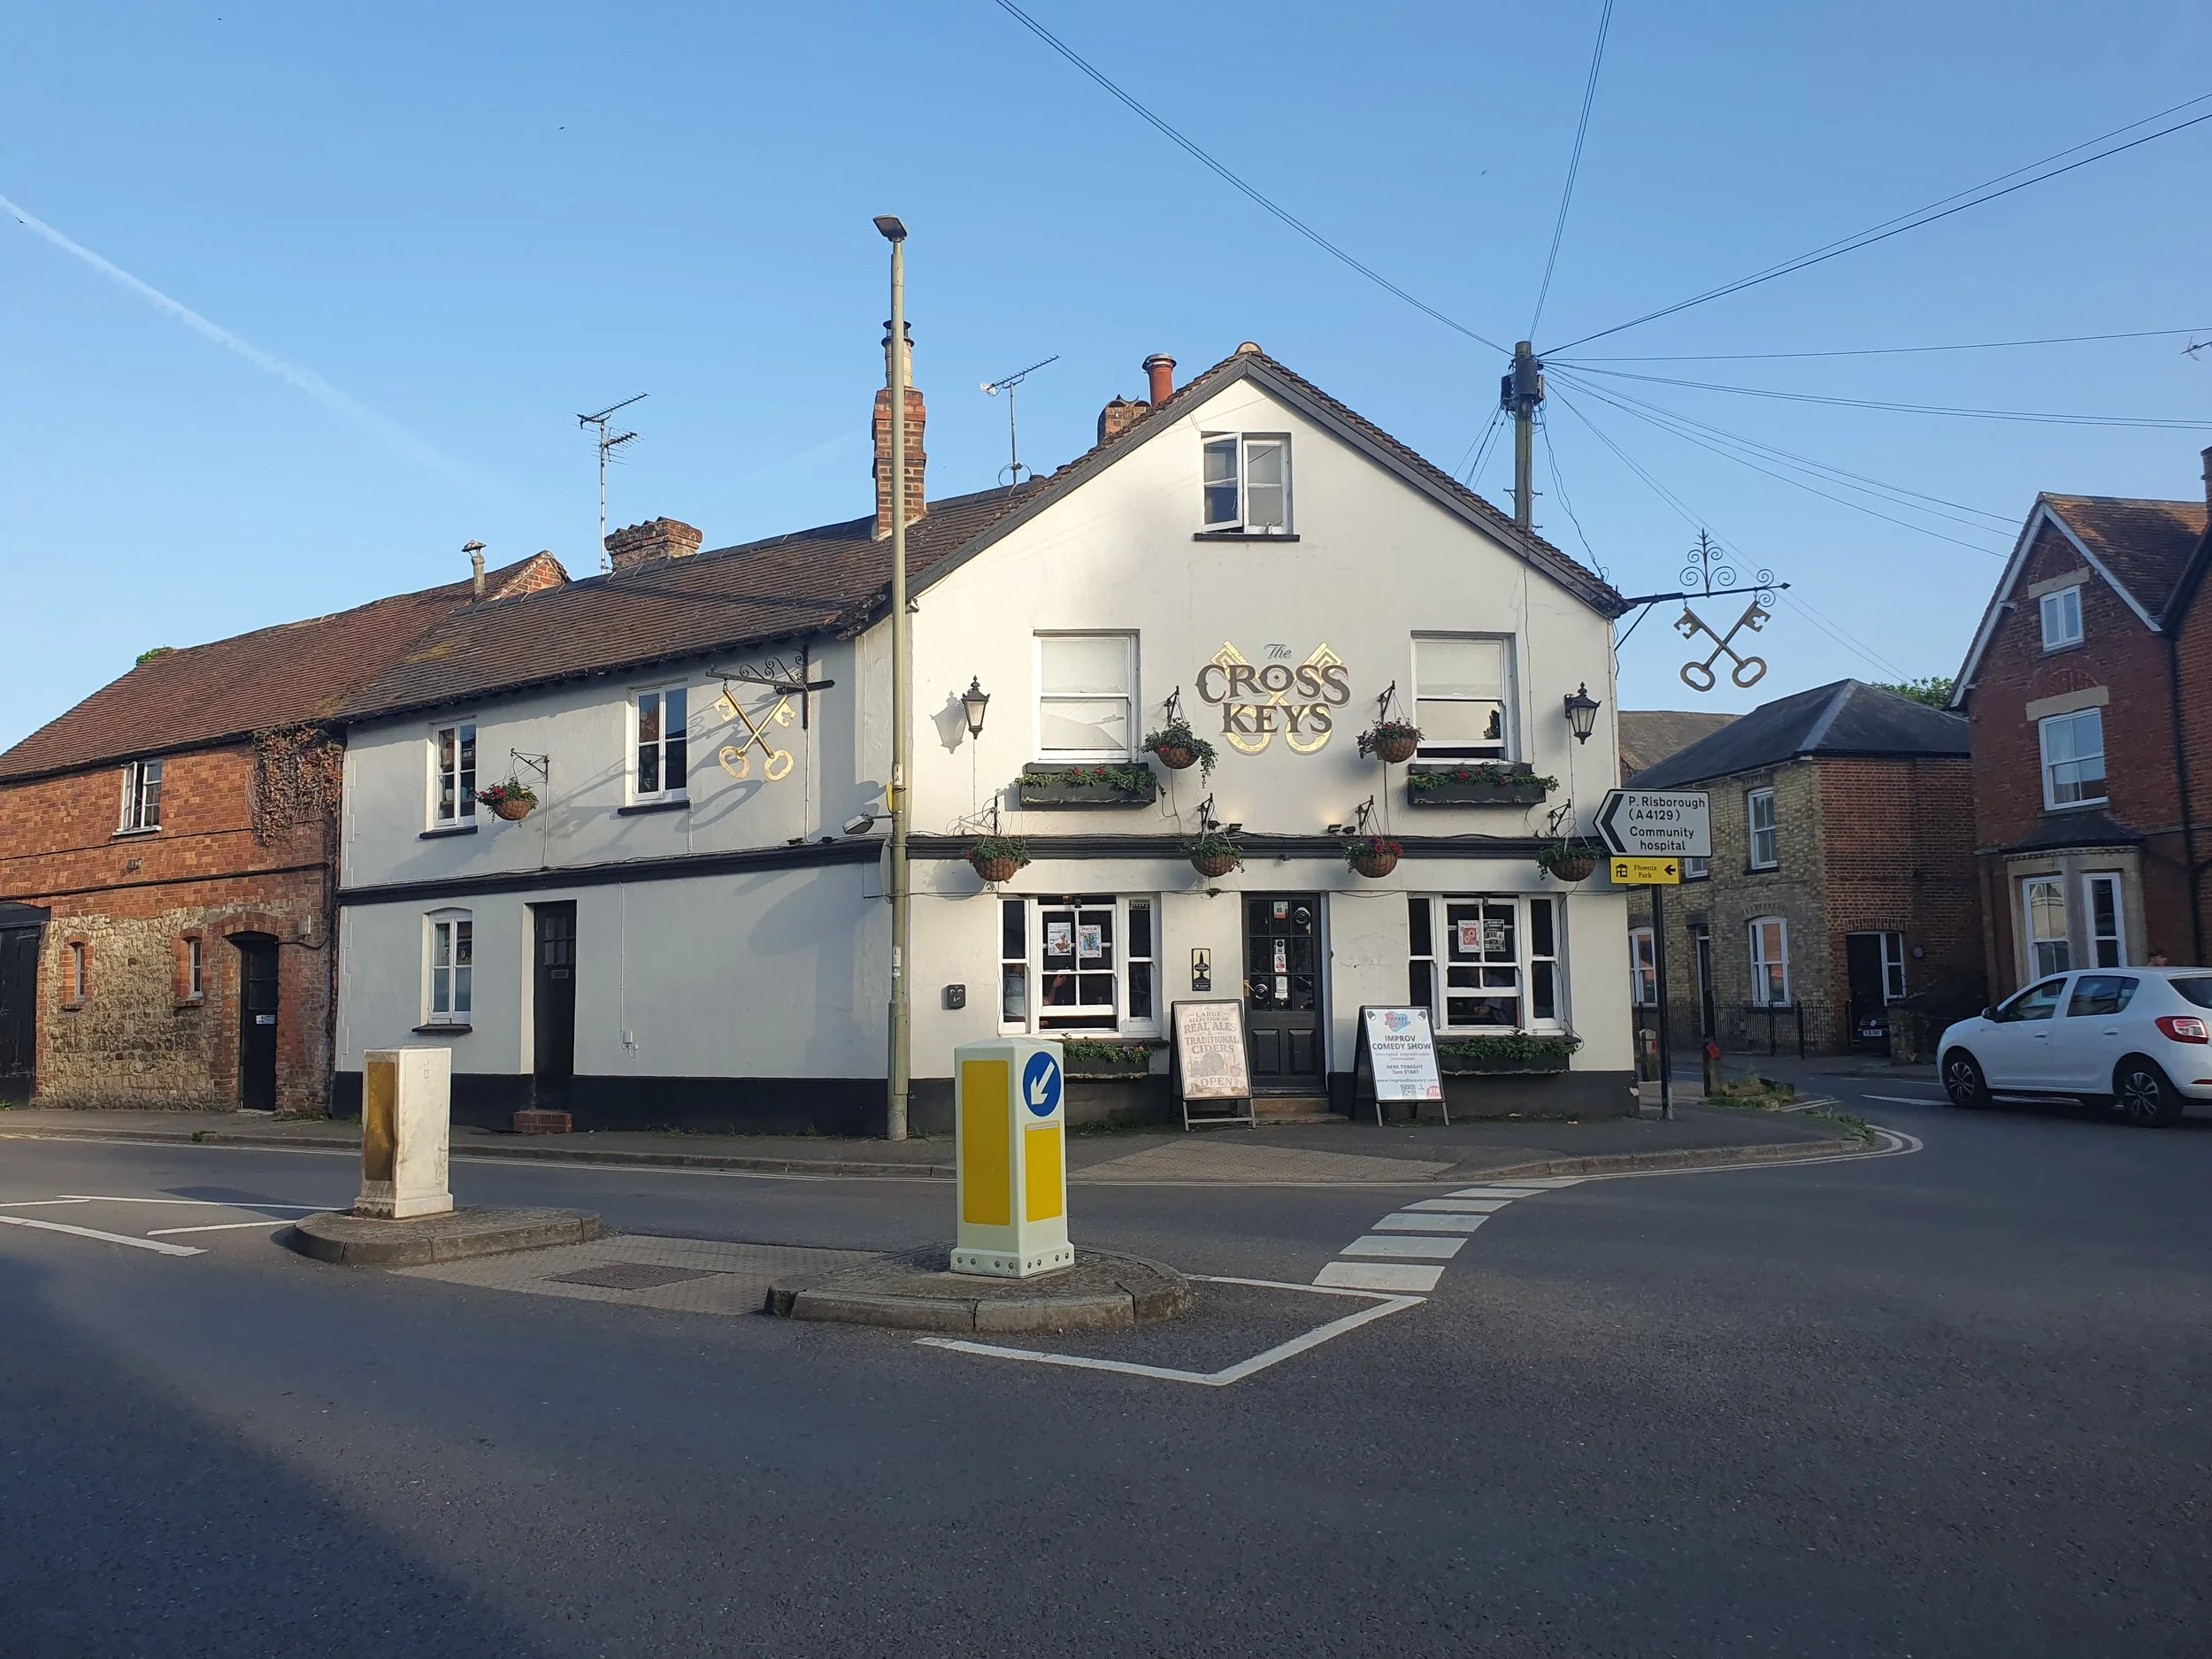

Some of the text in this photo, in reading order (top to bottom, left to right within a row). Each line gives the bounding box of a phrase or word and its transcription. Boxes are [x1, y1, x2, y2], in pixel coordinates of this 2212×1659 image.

[1263, 643, 1293, 659] The
[1194, 664, 1350, 705] CROSS
[1221, 703, 1333, 733] KEYS
[1629, 809, 1680, 821] (A4129)
[1629, 826, 1694, 839] Community
[1640, 840, 1686, 852] hospital
[1184, 1021, 1237, 1033] REAL ALES
[1185, 1036, 1239, 1046] TRADITIONAL
[1191, 1045, 1234, 1054] CIDERS
[1201, 1078, 1233, 1087] OPEN
